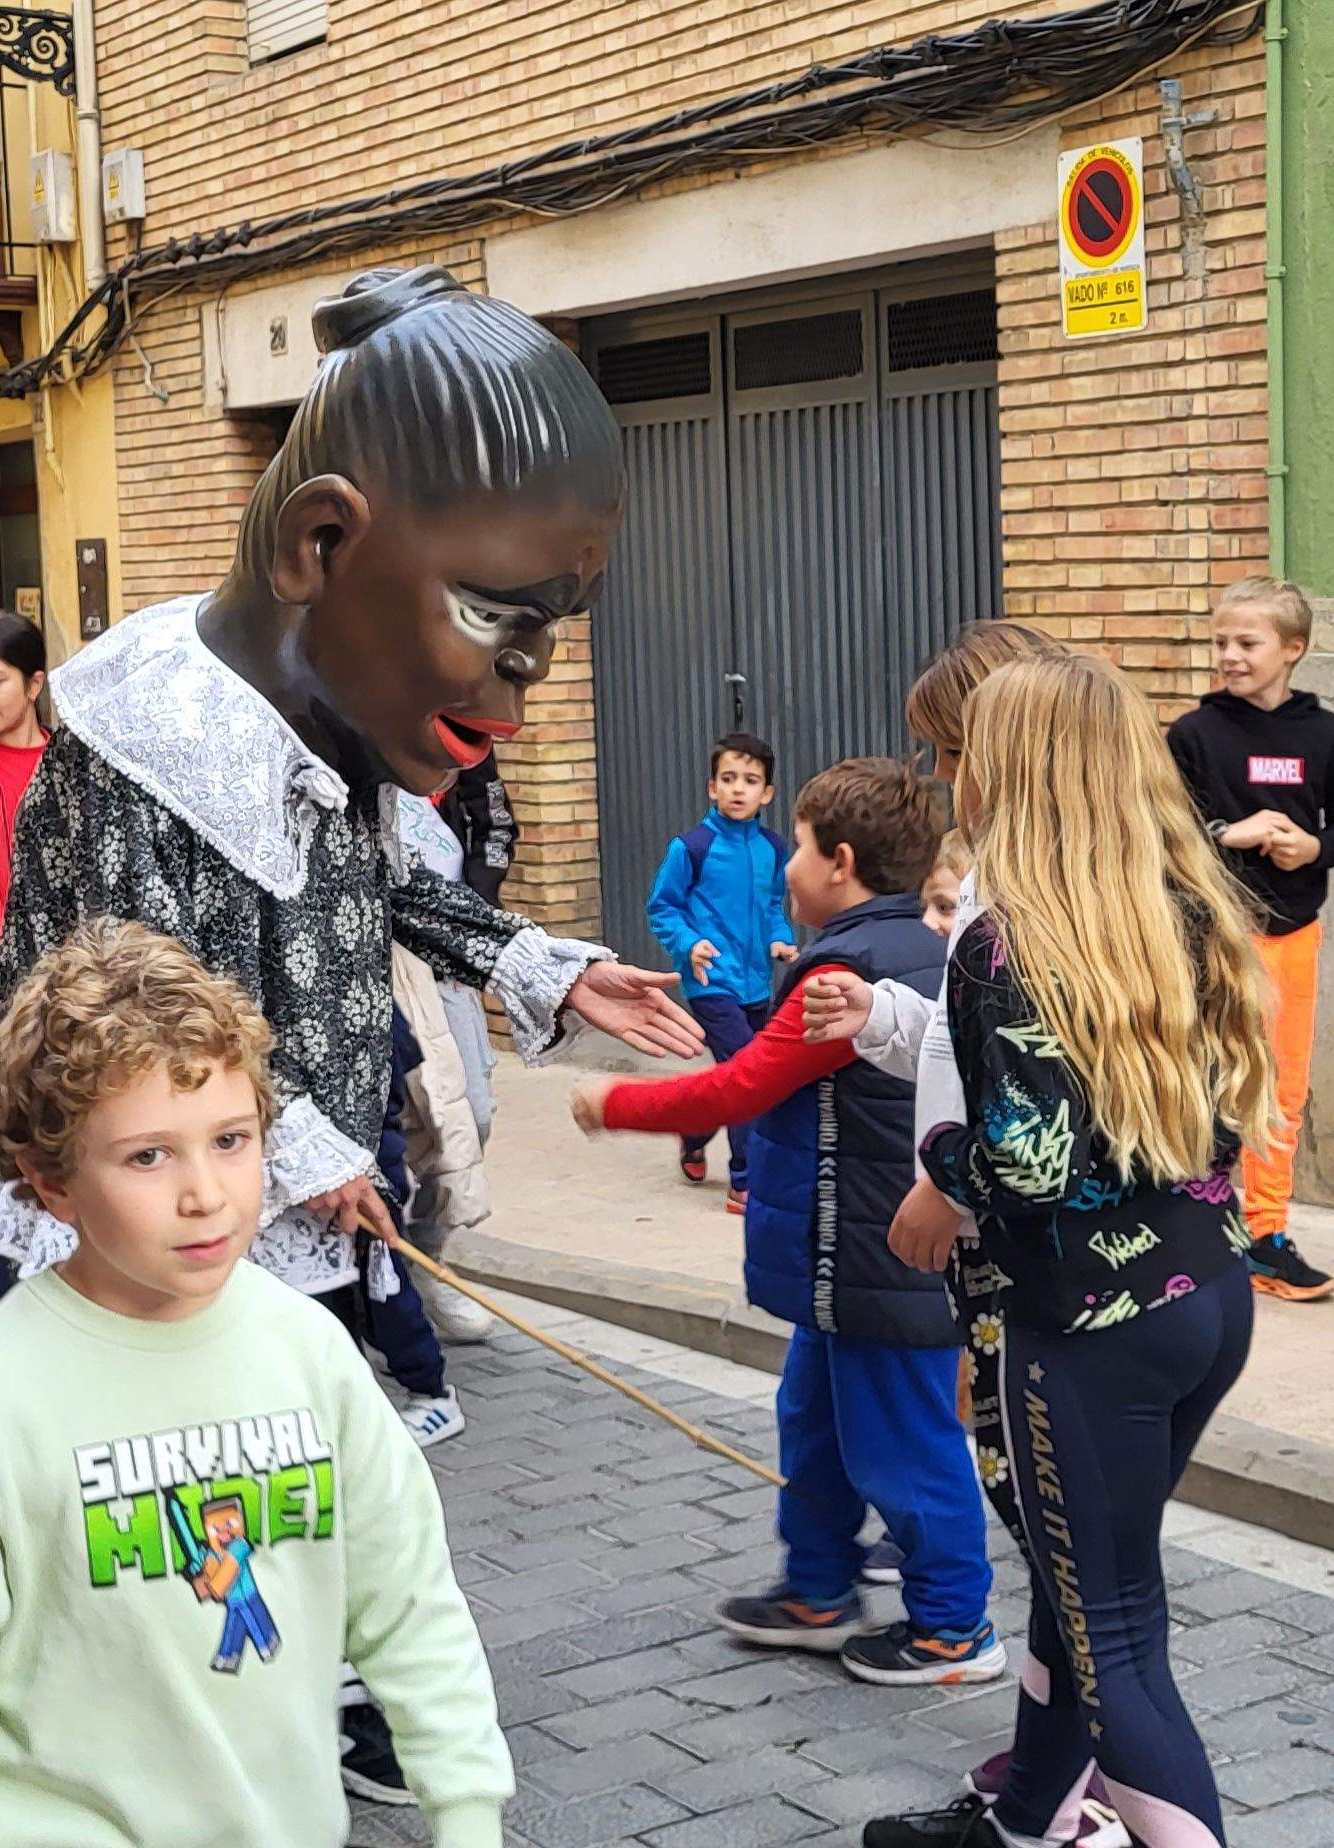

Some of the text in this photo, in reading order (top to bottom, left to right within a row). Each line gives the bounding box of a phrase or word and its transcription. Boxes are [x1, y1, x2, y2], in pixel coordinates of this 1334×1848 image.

[1067, 283, 1095, 303] VADO
[1249, 757, 1304, 784] MARVEL
[818, 1081, 838, 1151] FORWARD
[817, 1180, 837, 1251] FORWARD
[72, 1406, 334, 1506] SURVIVAL
[1023, 1388, 1101, 1707] MAKE IT HAPPEN
